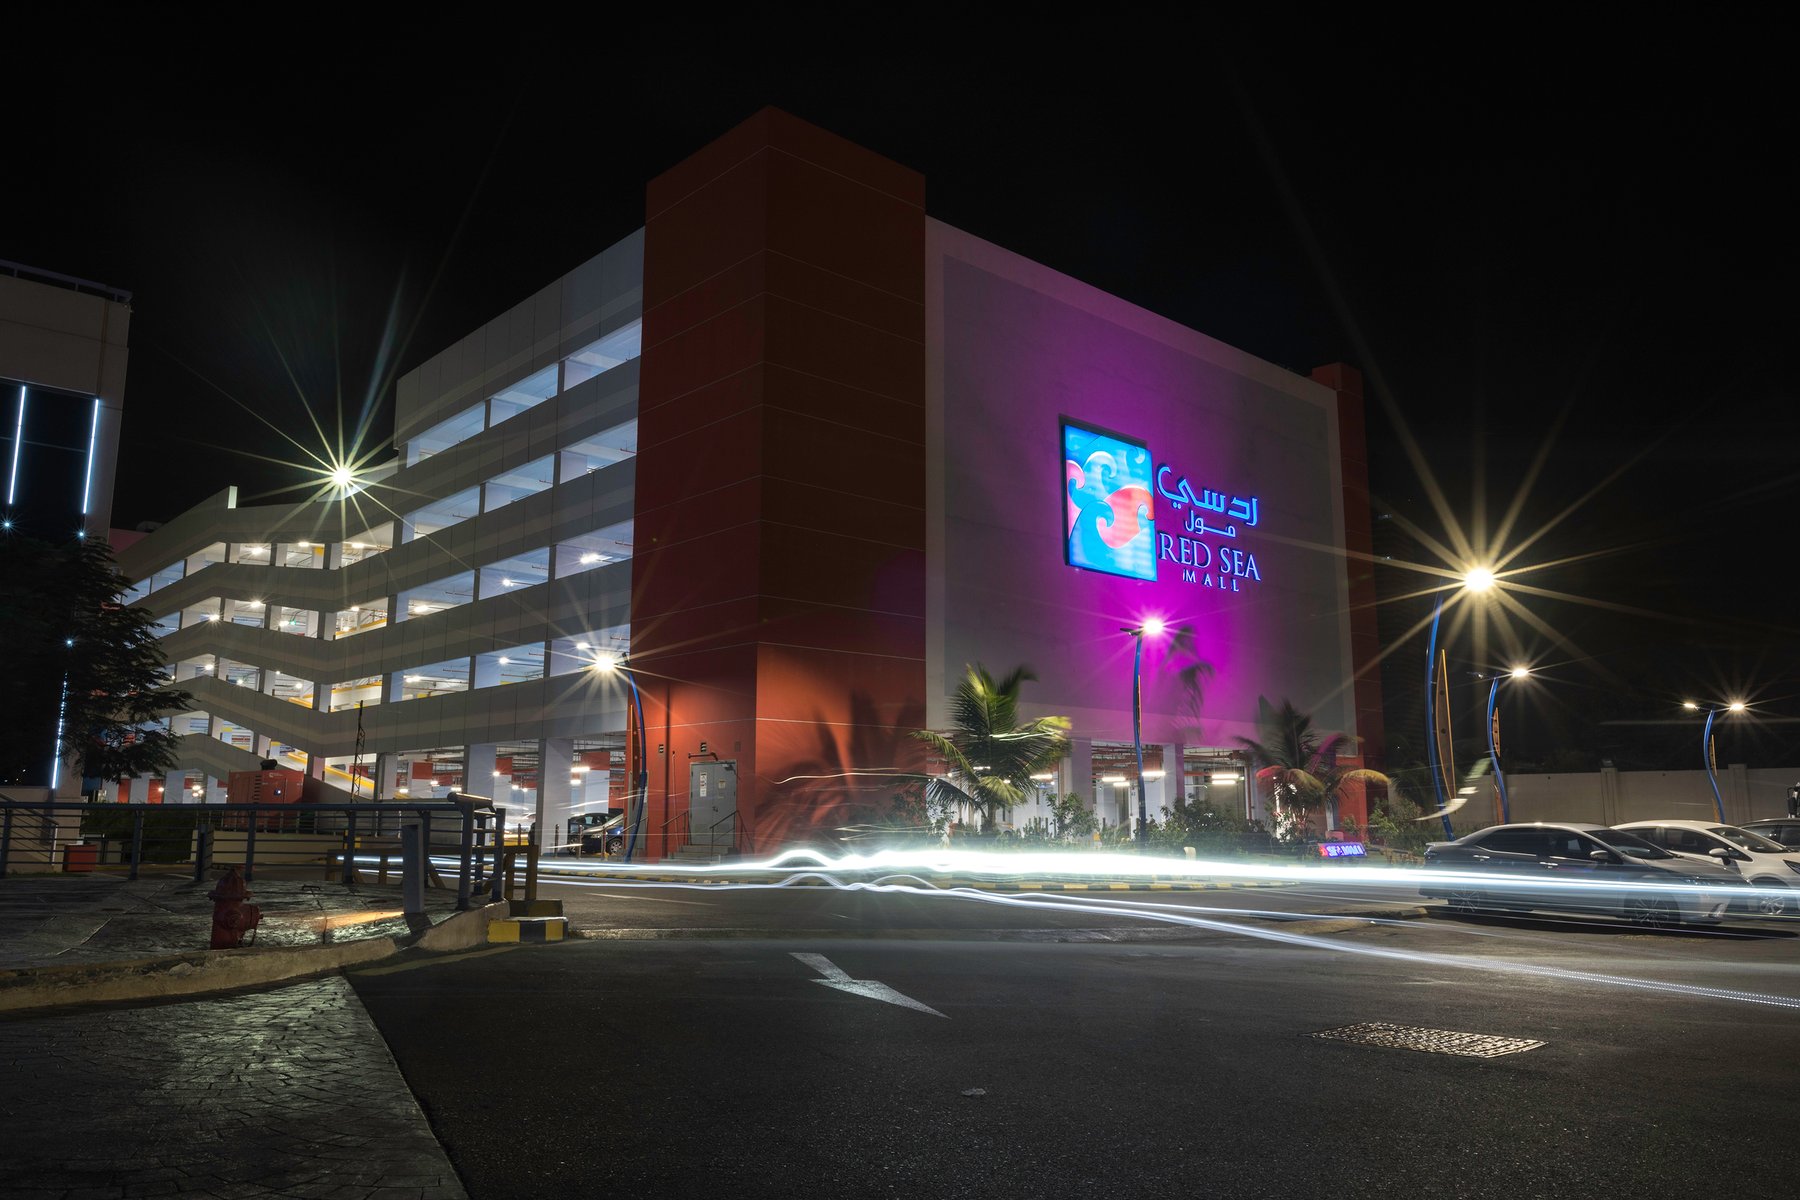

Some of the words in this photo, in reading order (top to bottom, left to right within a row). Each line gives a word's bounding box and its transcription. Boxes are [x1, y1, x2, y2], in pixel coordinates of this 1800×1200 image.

[1185, 510, 1236, 537] مول
[1159, 533, 1212, 568] RED
[1219, 547, 1261, 581] SEA
[1182, 569, 1239, 592] MALL
